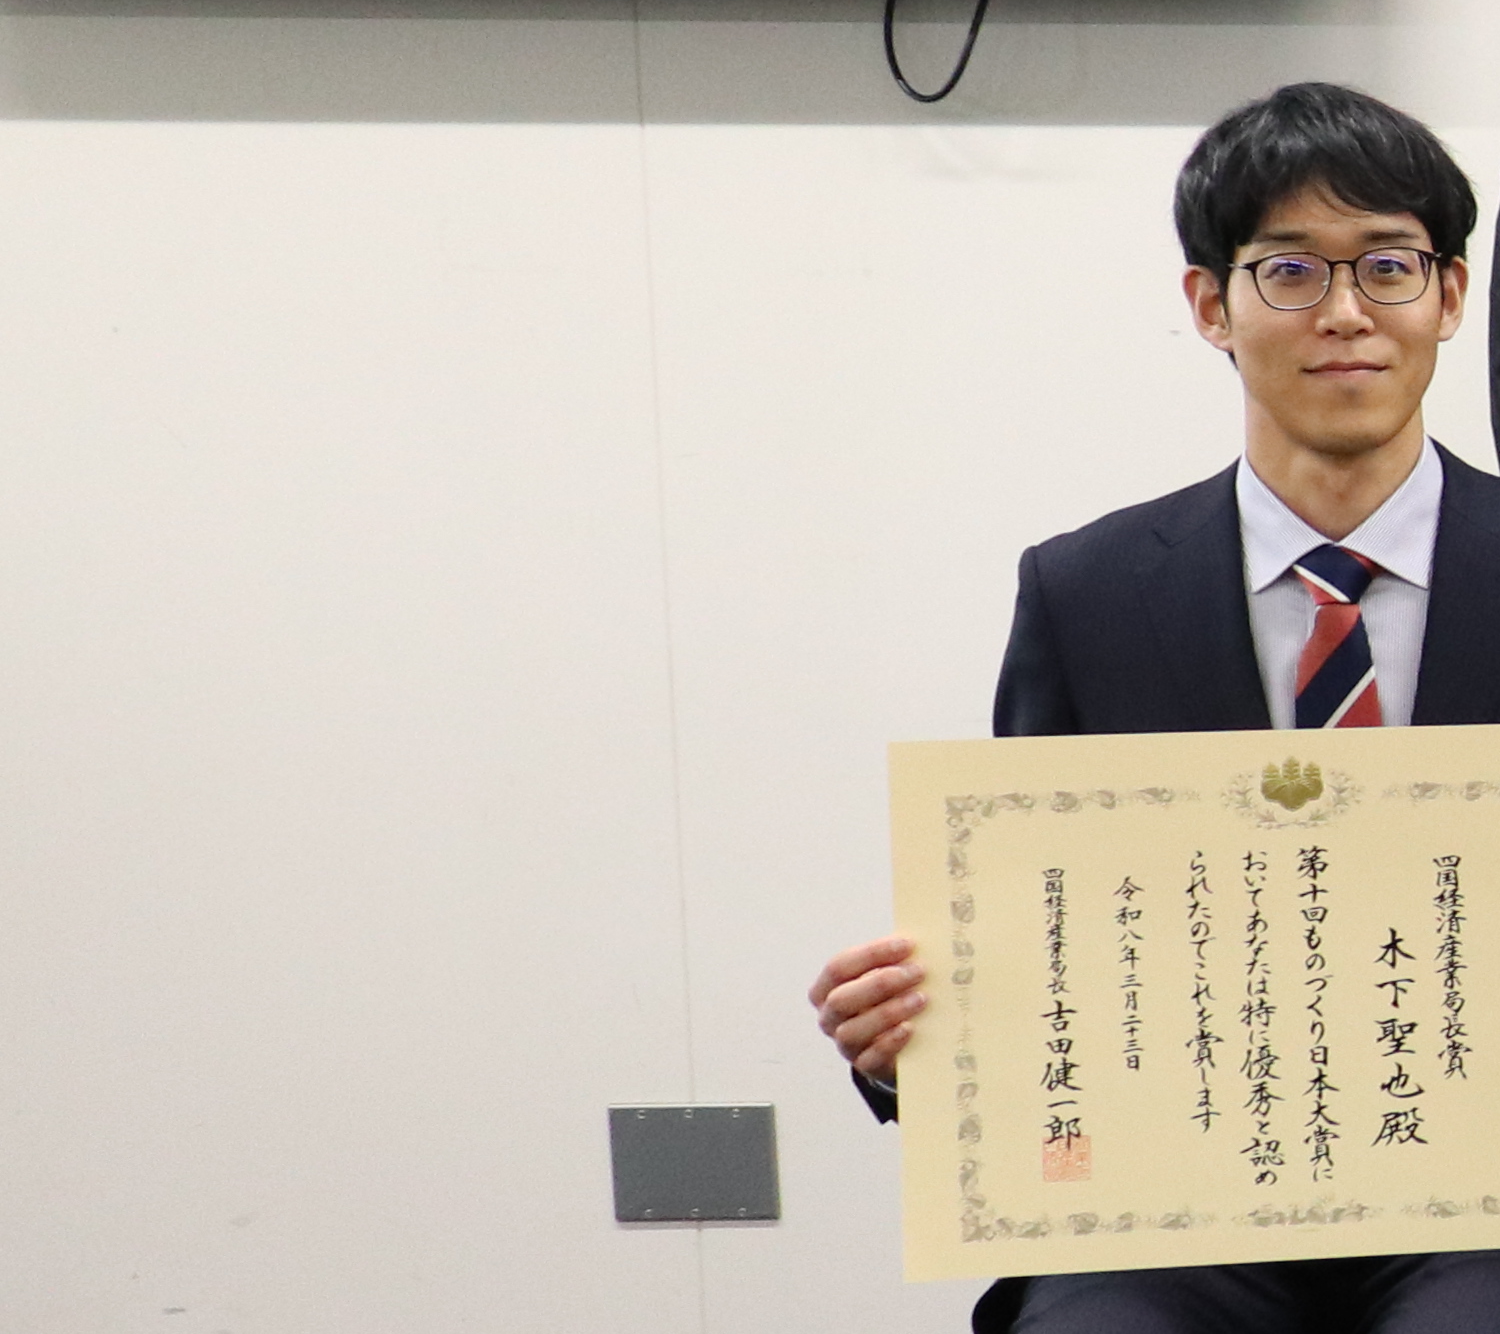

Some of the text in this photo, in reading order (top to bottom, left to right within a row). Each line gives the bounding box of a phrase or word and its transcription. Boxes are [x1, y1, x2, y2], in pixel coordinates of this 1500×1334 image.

[1114, 875, 1144, 1071] 令和八年三月二十三日
[1432, 854, 1473, 1079] 四国経済産業局長賞
